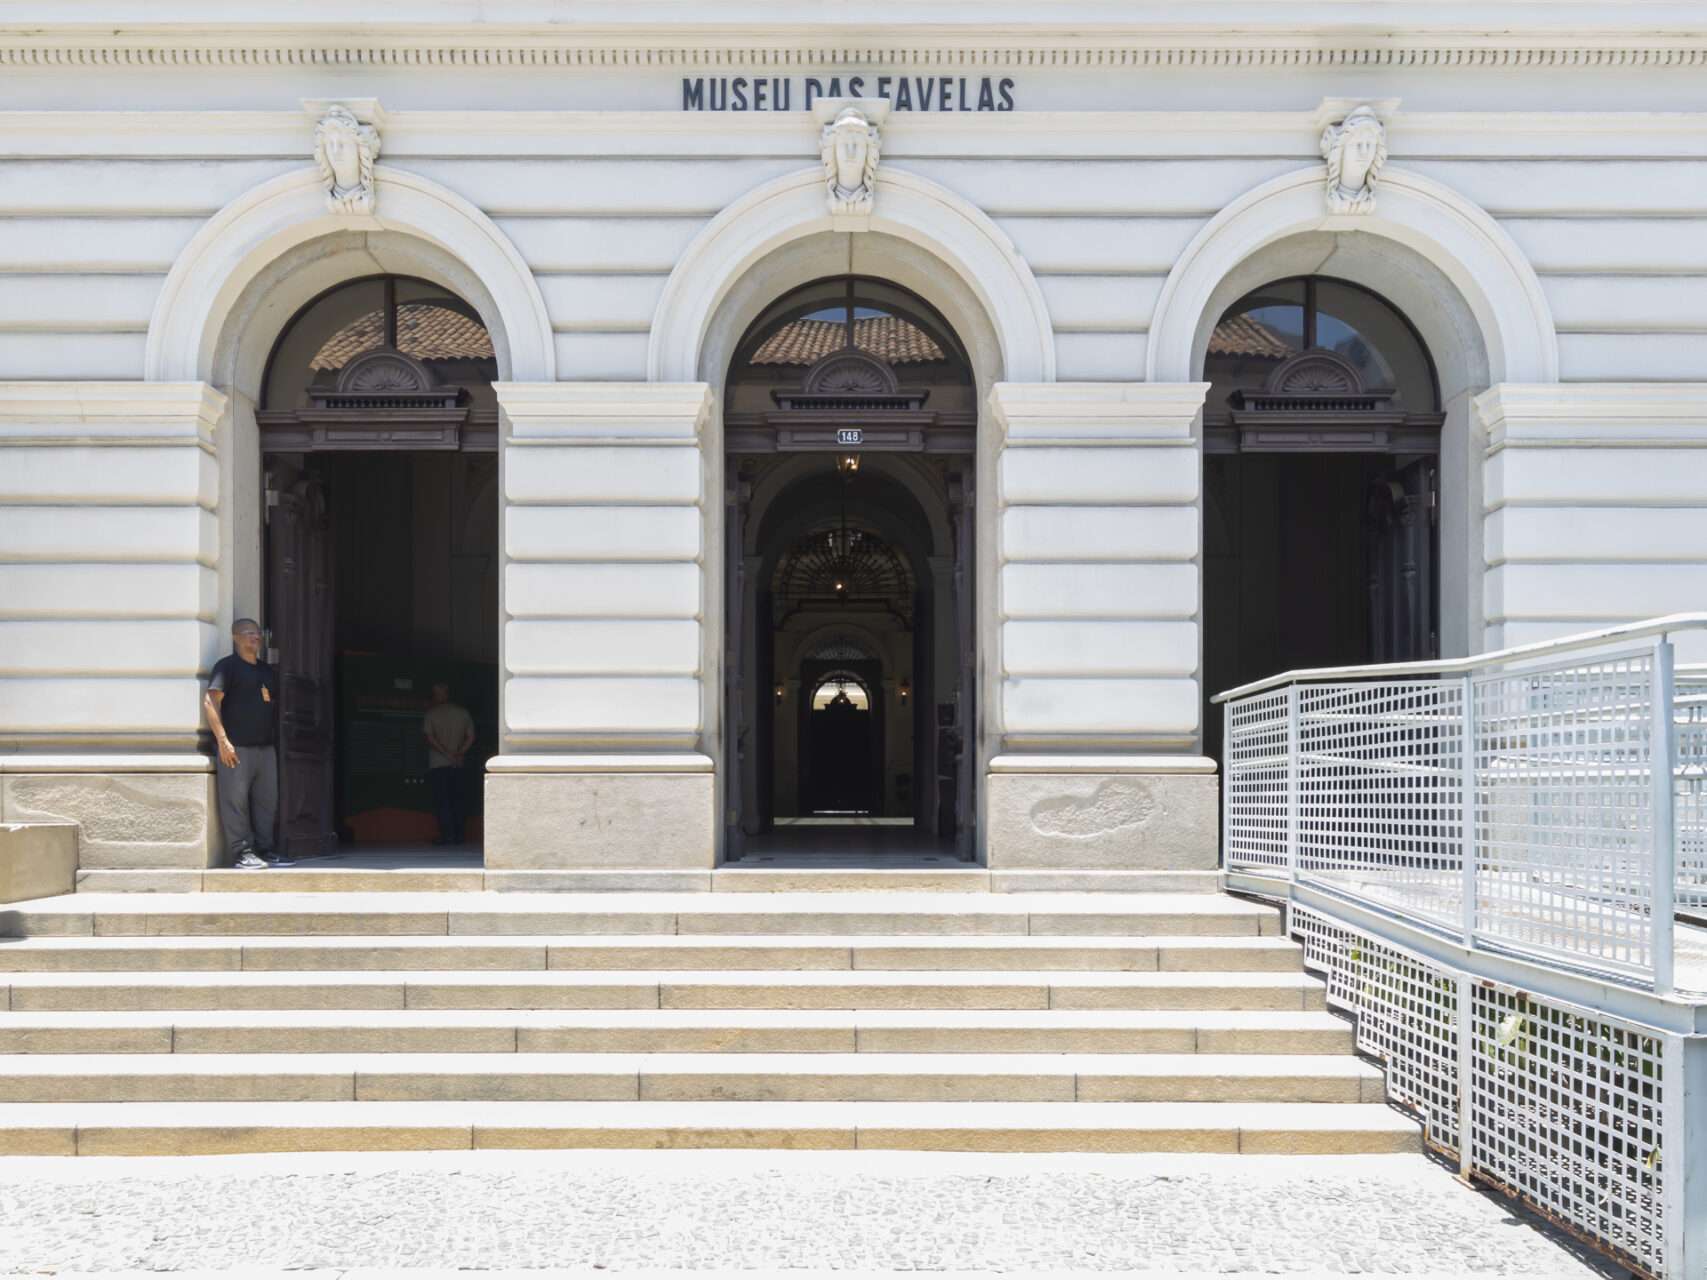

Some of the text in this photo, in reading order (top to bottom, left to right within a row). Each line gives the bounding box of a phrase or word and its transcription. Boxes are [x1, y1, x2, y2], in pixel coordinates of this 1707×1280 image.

[682, 77, 790, 111] MUSEU
[877, 76, 1015, 112] FAVELAS
[841, 431, 859, 441] 148
